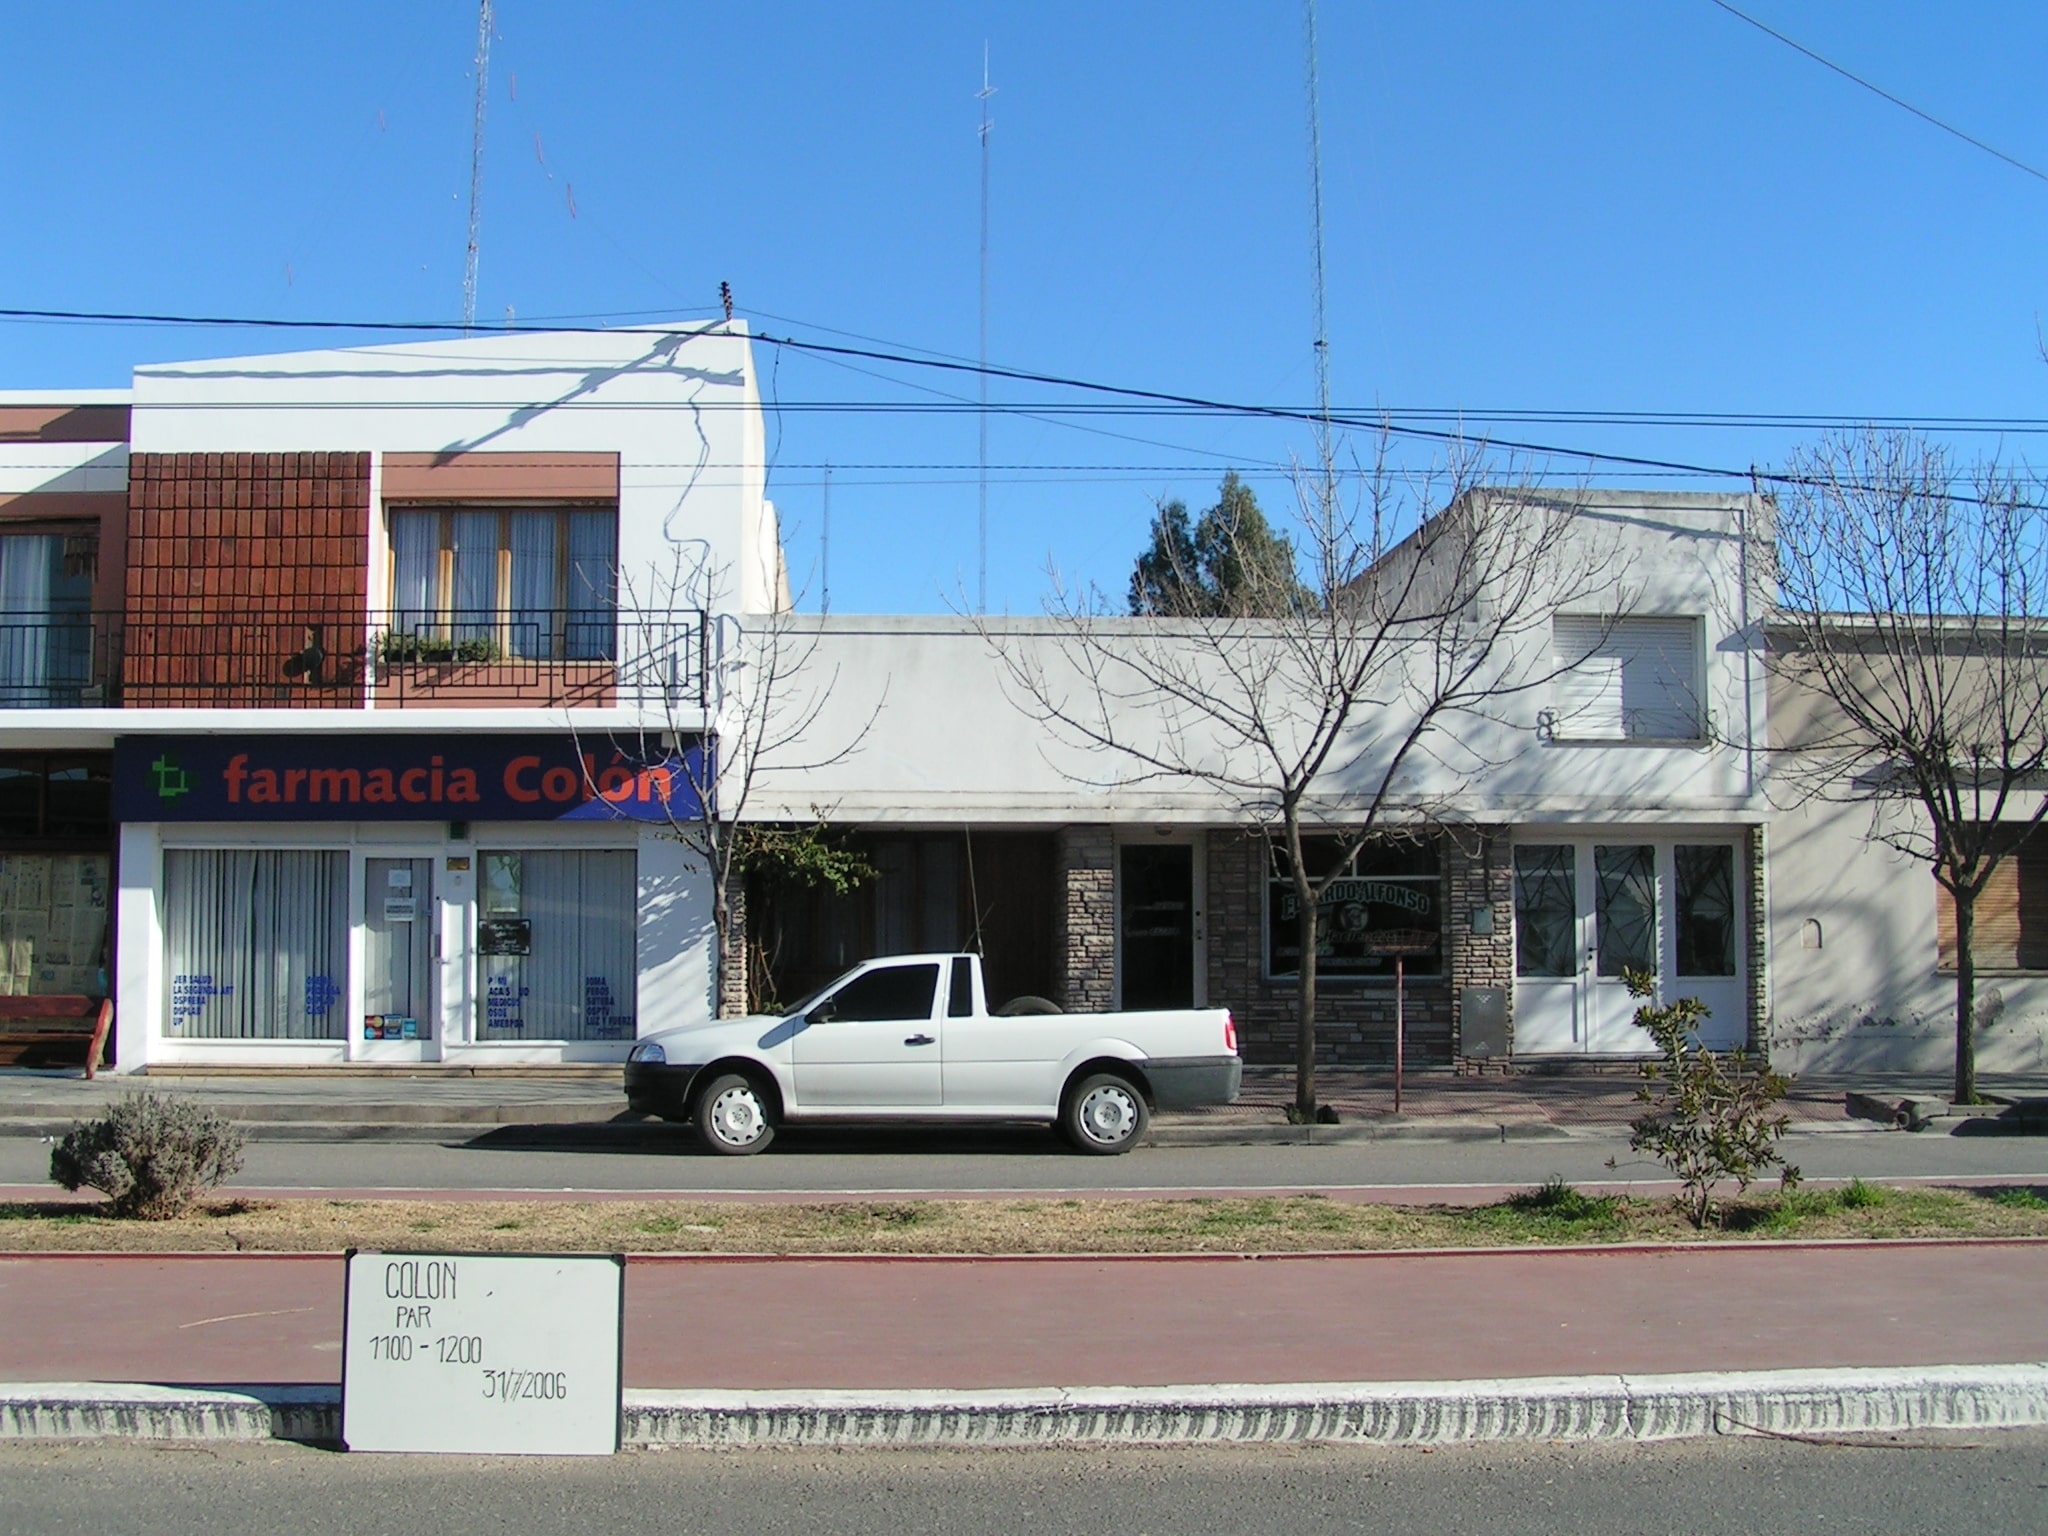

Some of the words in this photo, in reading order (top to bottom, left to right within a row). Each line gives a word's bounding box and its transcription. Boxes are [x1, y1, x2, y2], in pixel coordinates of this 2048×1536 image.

[223, 753, 480, 803] farmacia
[503, 752, 673, 803] Colón
[1281, 879, 1358, 920] EARDO
[1358, 880, 1430, 915] ALFONSO
[173, 986, 182, 995] LA
[184, 986, 218, 995] SEGUNDA
[488, 998, 520, 1006] MEDICUS
[488, 1008, 507, 1017] OSDE
[385, 1261, 457, 1299] COLON
[396, 1306, 431, 1328] PAR
[482, 1368, 567, 1402] 31/7/2006
